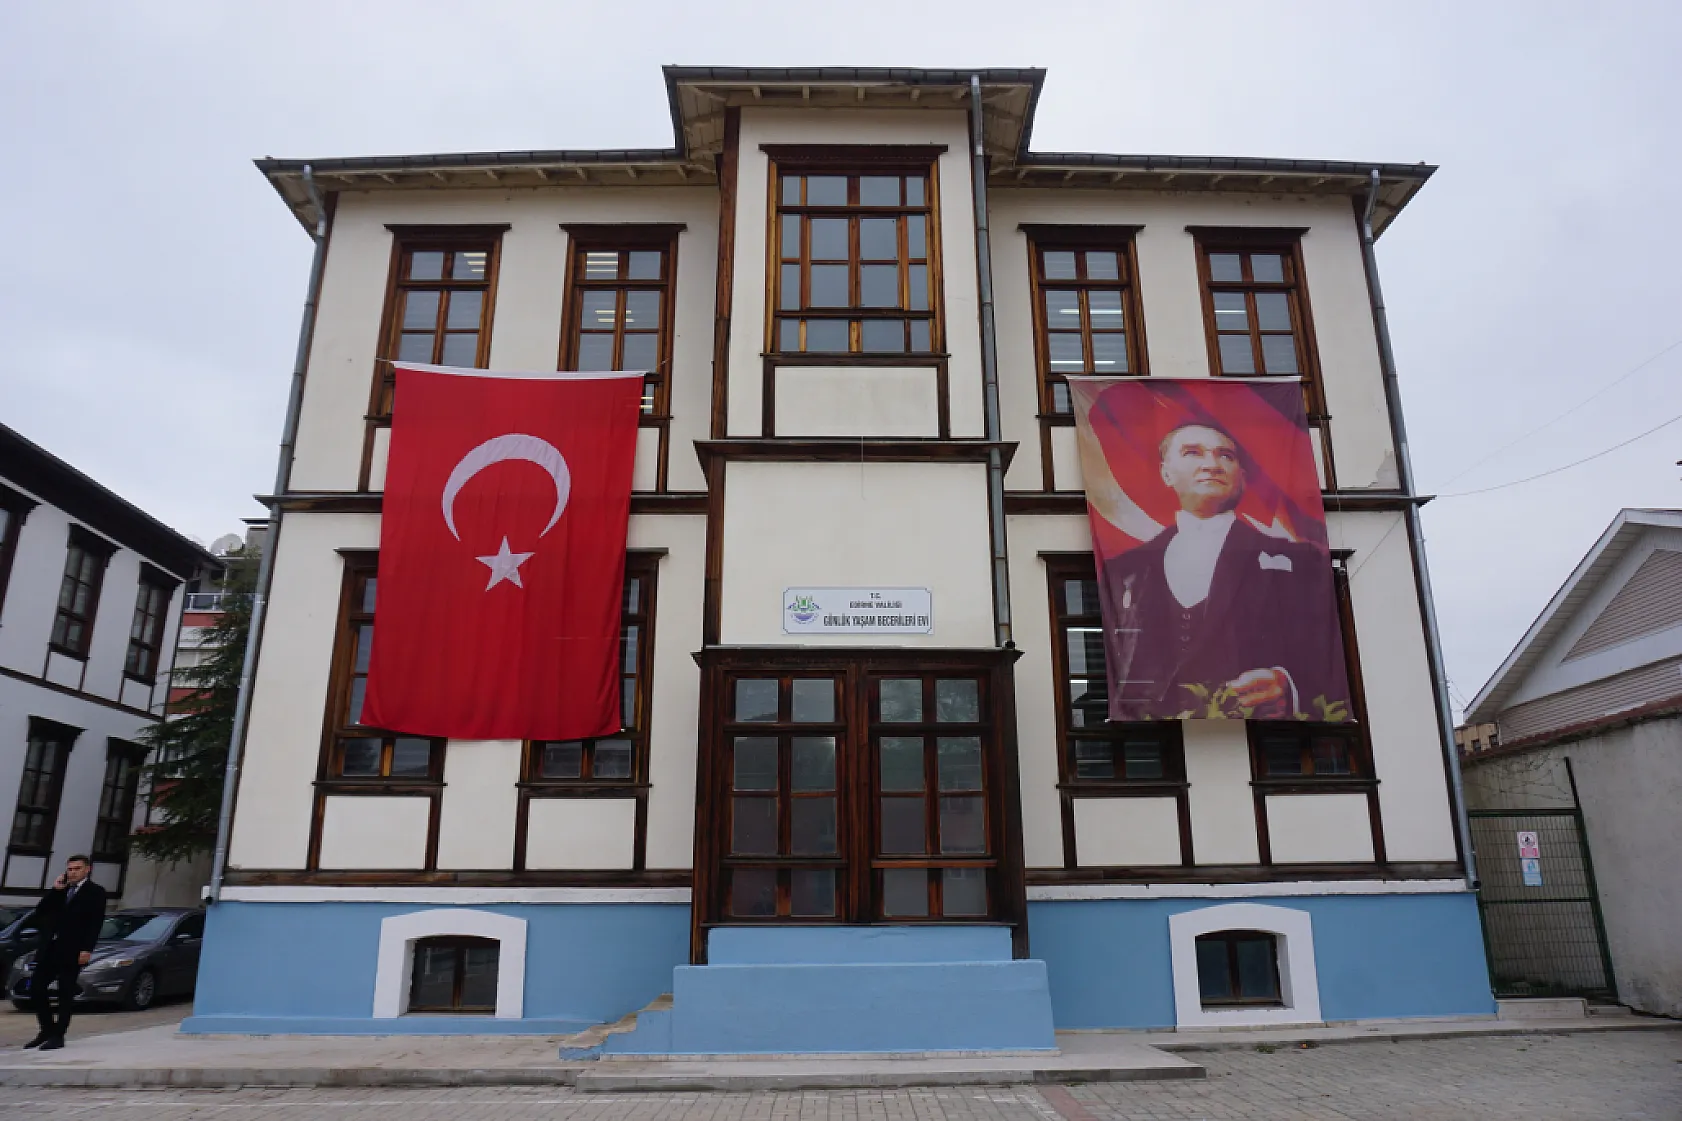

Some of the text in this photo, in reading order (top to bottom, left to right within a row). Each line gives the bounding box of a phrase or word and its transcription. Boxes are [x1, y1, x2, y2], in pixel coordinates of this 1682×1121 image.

[823, 613, 929, 629] GÜNLÜK YAŞAM BECERİLERİ EVİ
